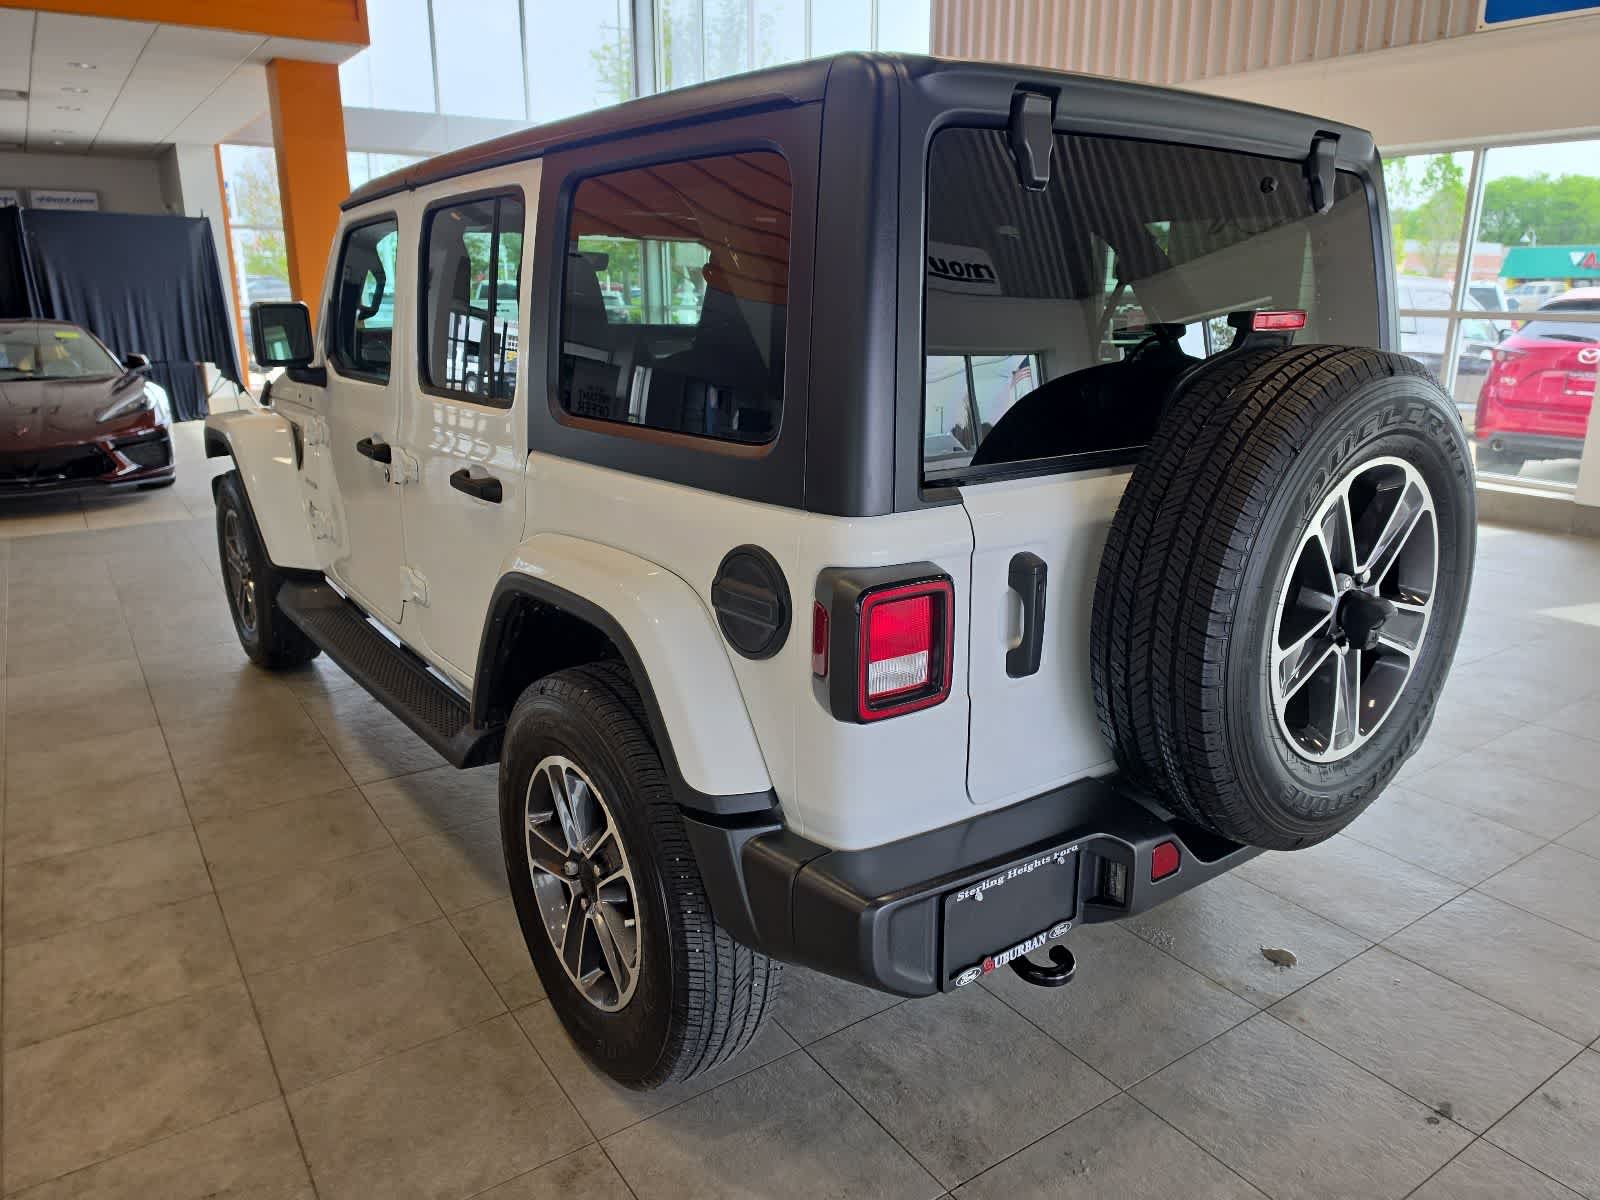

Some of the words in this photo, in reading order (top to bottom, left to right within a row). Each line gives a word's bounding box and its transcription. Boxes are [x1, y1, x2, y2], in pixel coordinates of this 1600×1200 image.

[956, 875, 1005, 902] Sterling
[1007, 856, 1051, 880] Heights
[983, 932, 1047, 975] SUBURBAN
